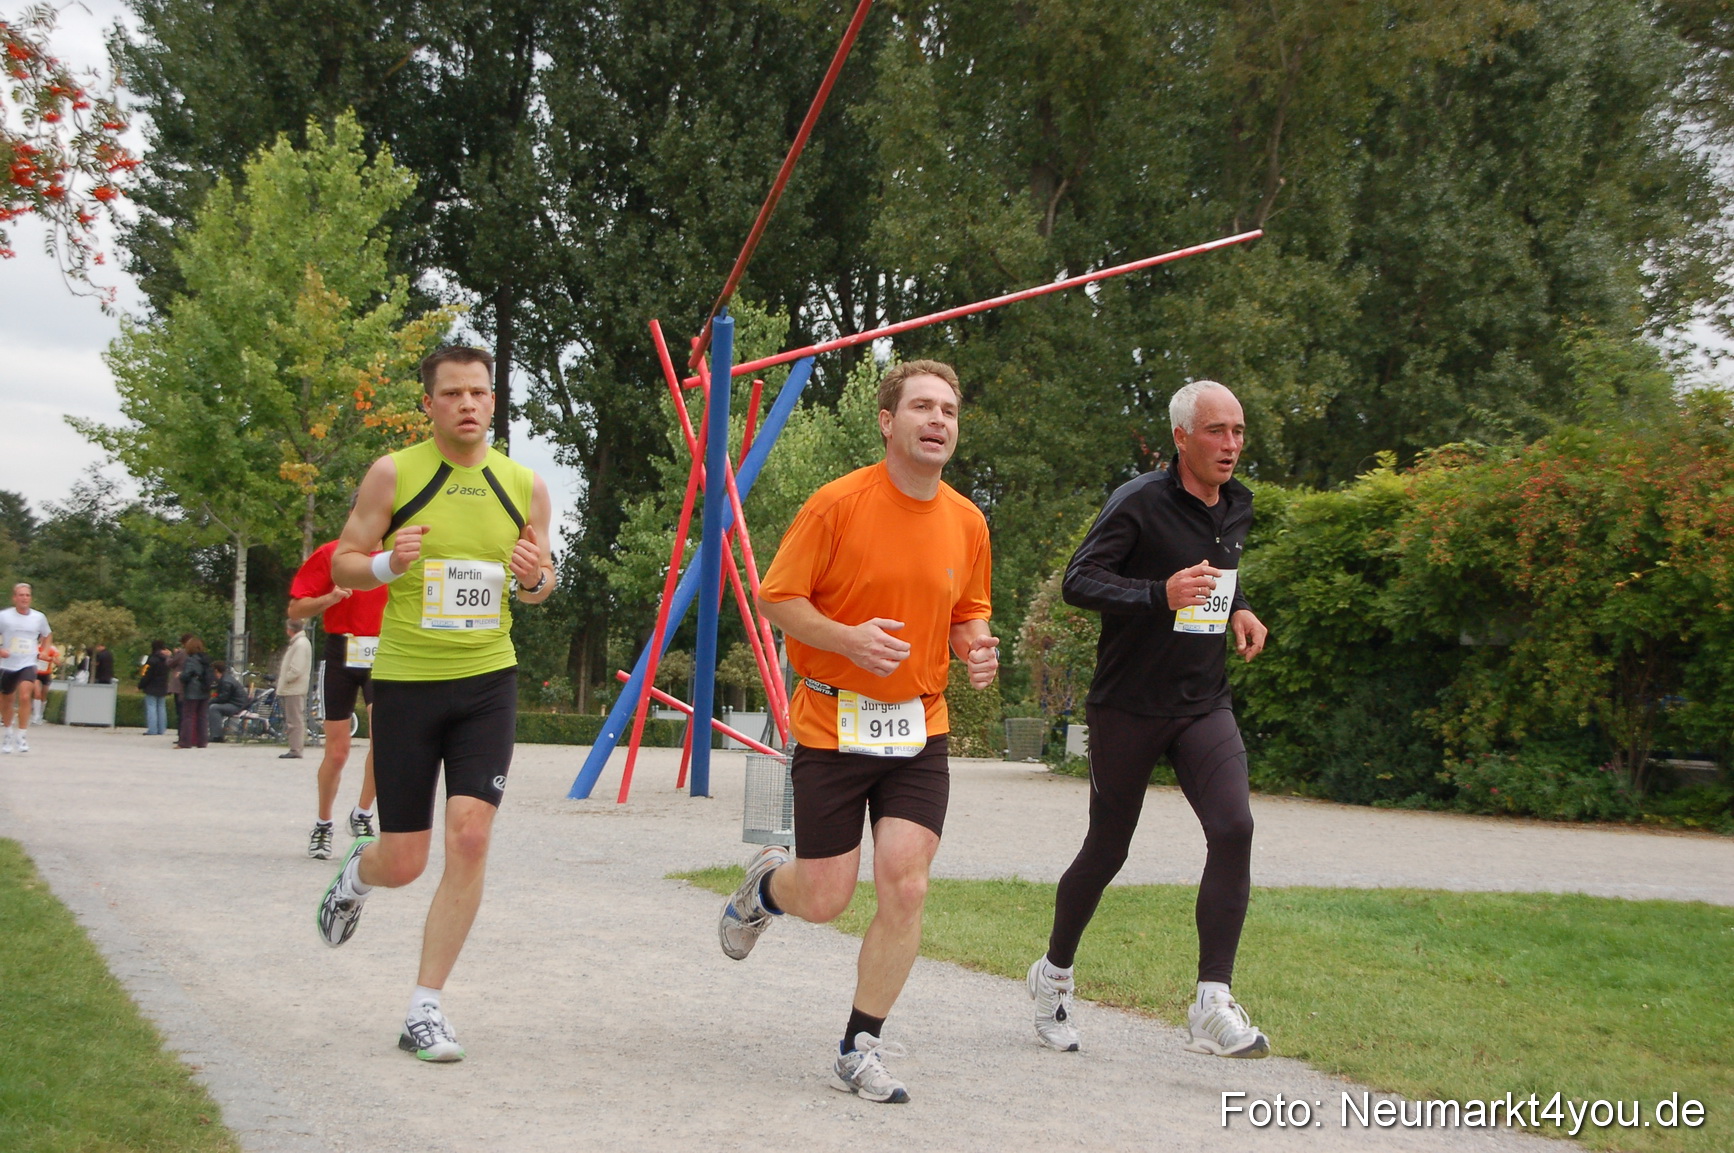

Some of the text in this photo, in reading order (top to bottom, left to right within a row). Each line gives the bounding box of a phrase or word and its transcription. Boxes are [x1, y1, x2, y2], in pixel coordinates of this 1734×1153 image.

[460, 486, 487, 497] asics
[448, 566, 482, 580] Martin
[427, 585, 433, 596] B
[455, 588, 491, 607] 580
[1203, 595, 1229, 613] 596
[841, 717, 847, 727] B
[869, 718, 910, 738] 918
